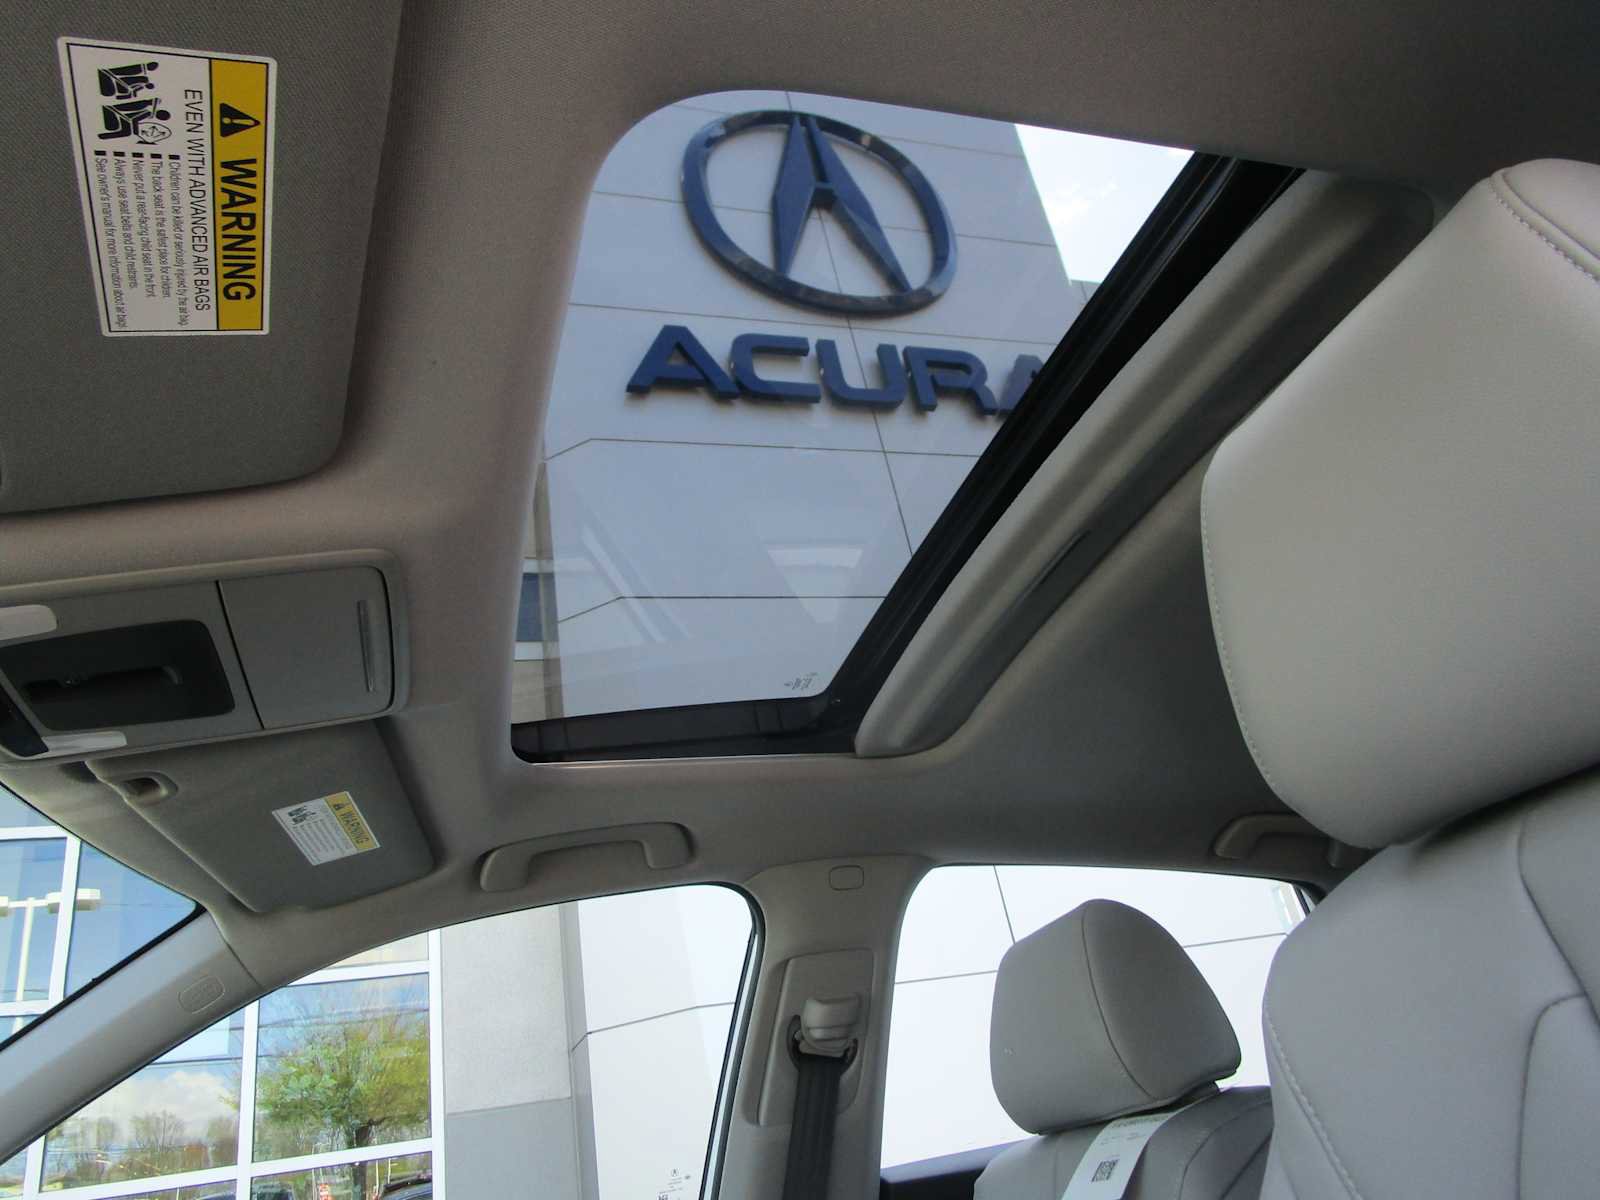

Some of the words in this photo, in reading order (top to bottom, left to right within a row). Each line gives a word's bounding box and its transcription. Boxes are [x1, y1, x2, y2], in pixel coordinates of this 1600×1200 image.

[184, 89, 204, 133] EVEN
[187, 138, 205, 176] WITH
[95, 158, 108, 173] See
[113, 159, 127, 184] Always
[132, 160, 145, 181] Never
[152, 161, 163, 175] The
[170, 161, 182, 190] Children
[98, 174, 112, 201] owner's
[117, 185, 128, 199] use
[132, 182, 146, 194] put
[152, 176, 165, 192] back
[119, 200, 132, 214] seat
[153, 194, 165, 209] seat
[171, 192, 181, 206] can
[103, 202, 117, 228] manual
[137, 201, 150, 236] rear-facing
[172, 206, 183, 215] be
[189, 178, 208, 253] ADVANCED
[121, 215, 133, 231] belts
[156, 217, 167, 227] the
[173, 216, 184, 232] killed
[220, 158, 257, 300] WARNING
[105, 228, 118, 238] for
[123, 232, 135, 245] and
[157, 229, 169, 247] safest
[106, 238, 117, 255] more
[141, 237, 153, 251] child
[125, 245, 137, 260] child
[142, 252, 153, 266] seat
[156, 249, 168, 265] place
[173, 241, 186, 267] seriously
[110, 256, 122, 288] information
[160, 266, 171, 274] for
[192, 255, 209, 276] AIR
[144, 273, 155, 284] the
[175, 269, 186, 288] injured
[114, 289, 125, 304] about
[194, 279, 211, 311] BAGS
